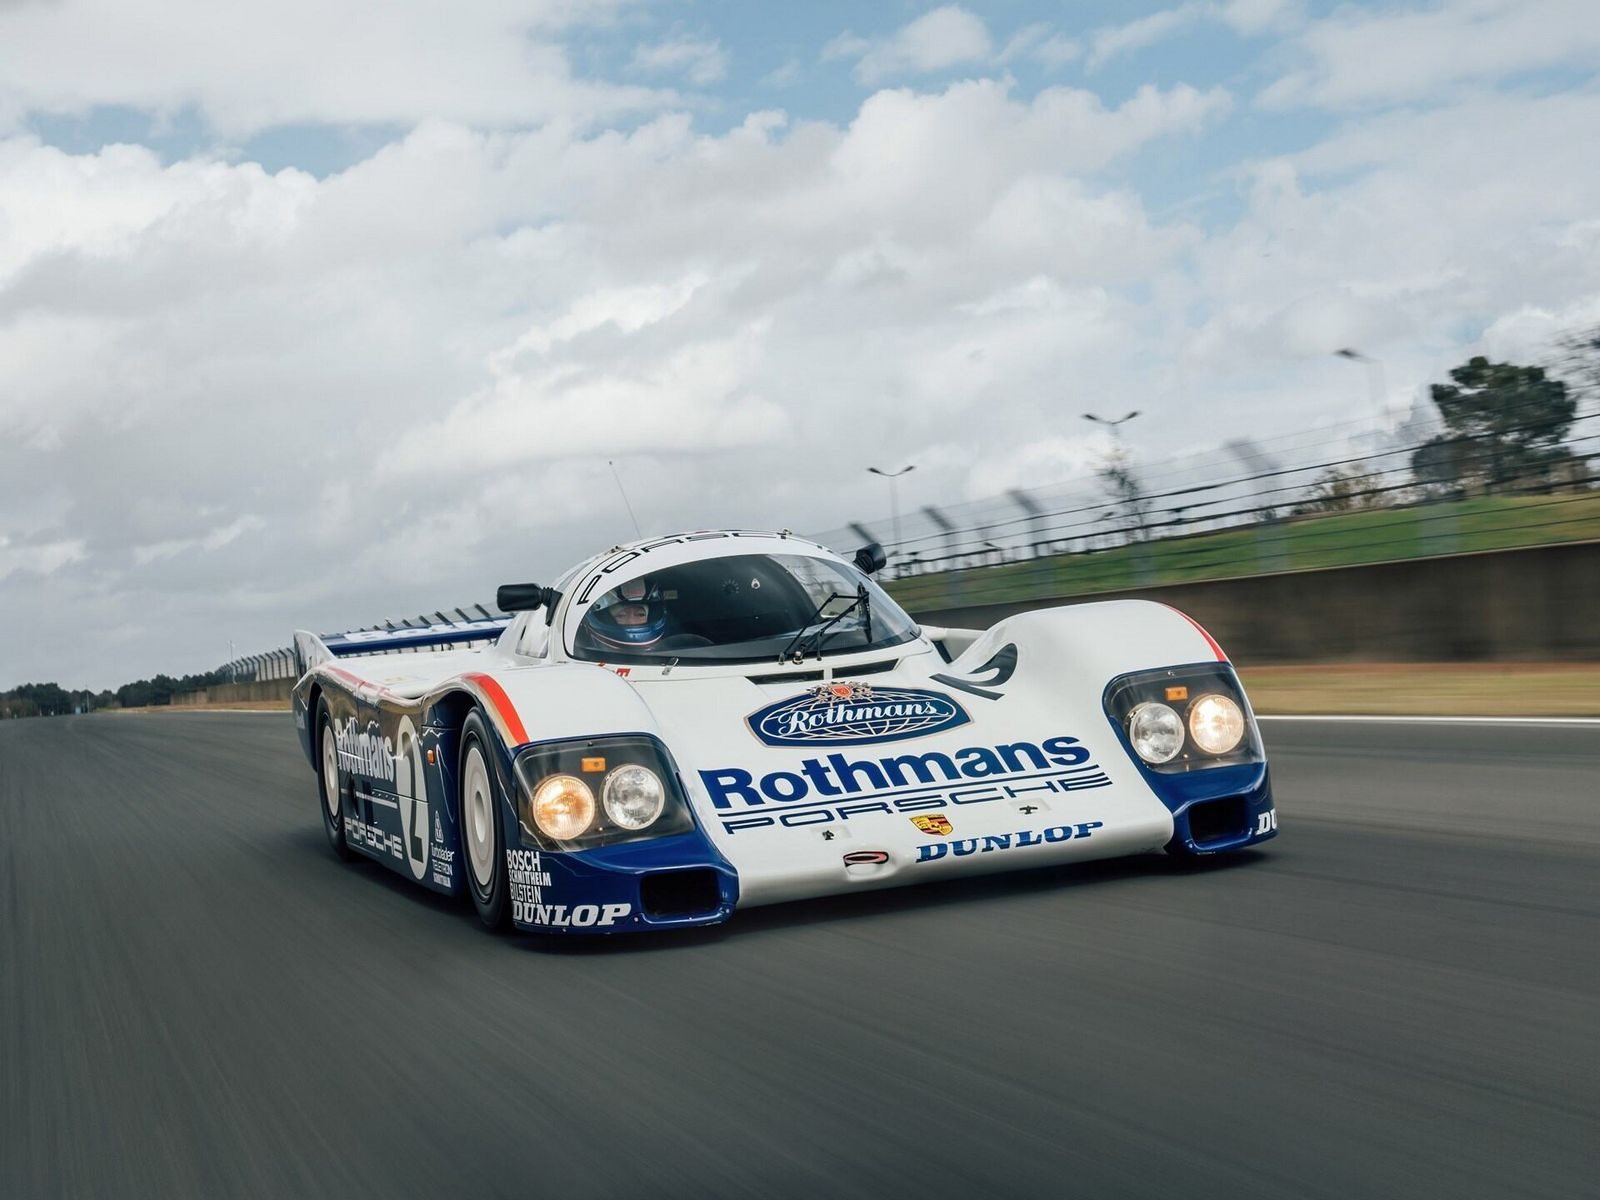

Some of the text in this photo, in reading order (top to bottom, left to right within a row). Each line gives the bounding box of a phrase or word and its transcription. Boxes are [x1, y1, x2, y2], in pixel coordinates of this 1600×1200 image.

[776, 697, 950, 736] Rothmans
[334, 717, 394, 783] Rothmans
[698, 735, 1091, 809] Rothmans
[721, 772, 1113, 835] PORSCHE
[344, 817, 403, 860] PORSCHE
[915, 821, 1103, 863] DUNLOP
[506, 849, 541, 872] BOSCH
[509, 883, 542, 904] BILSTEIN
[512, 901, 632, 927] DUNLOP
